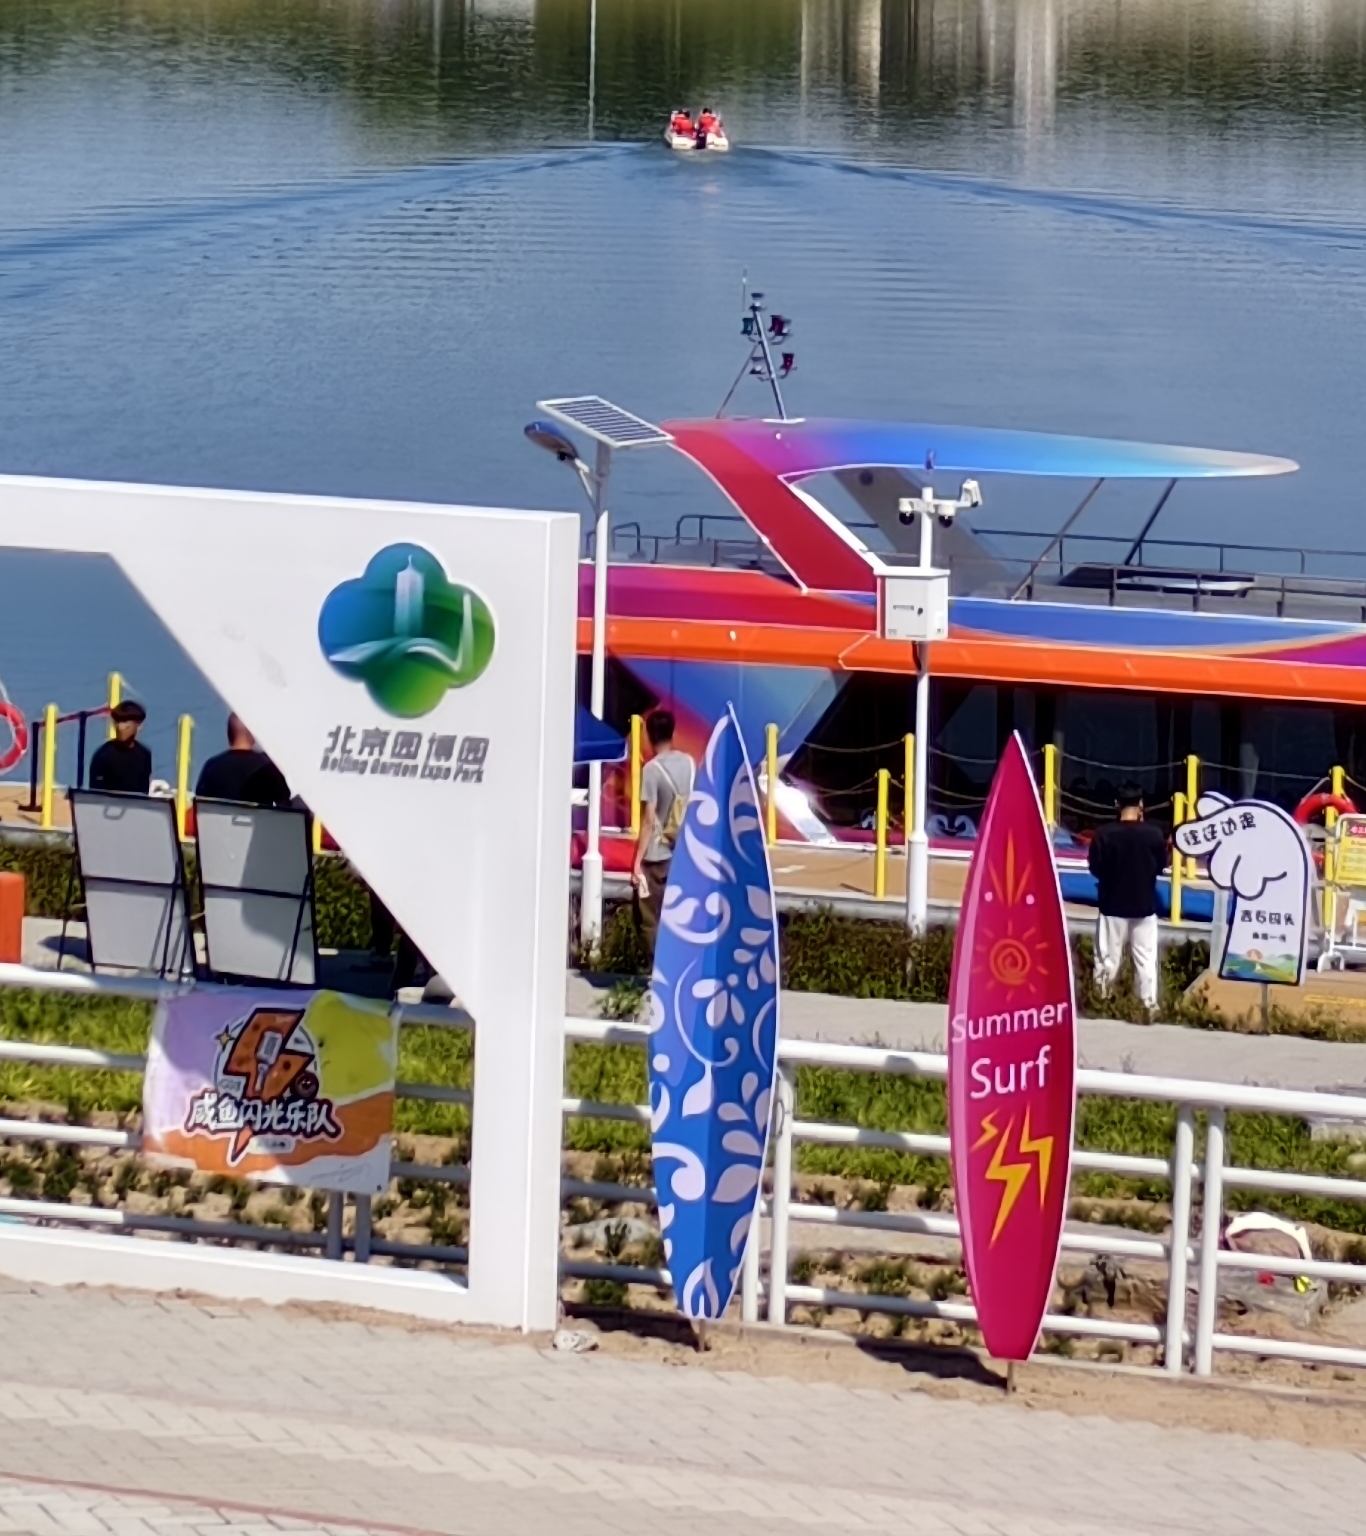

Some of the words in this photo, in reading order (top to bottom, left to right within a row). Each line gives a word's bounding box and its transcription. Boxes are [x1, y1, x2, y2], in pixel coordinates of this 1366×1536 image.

[323, 724, 490, 765] 北京园博园
[951, 1001, 1069, 1044] Summer
[970, 1044, 1052, 1100] Surf
[187, 1091, 337, 1134] 咸鱼闪光乐队
